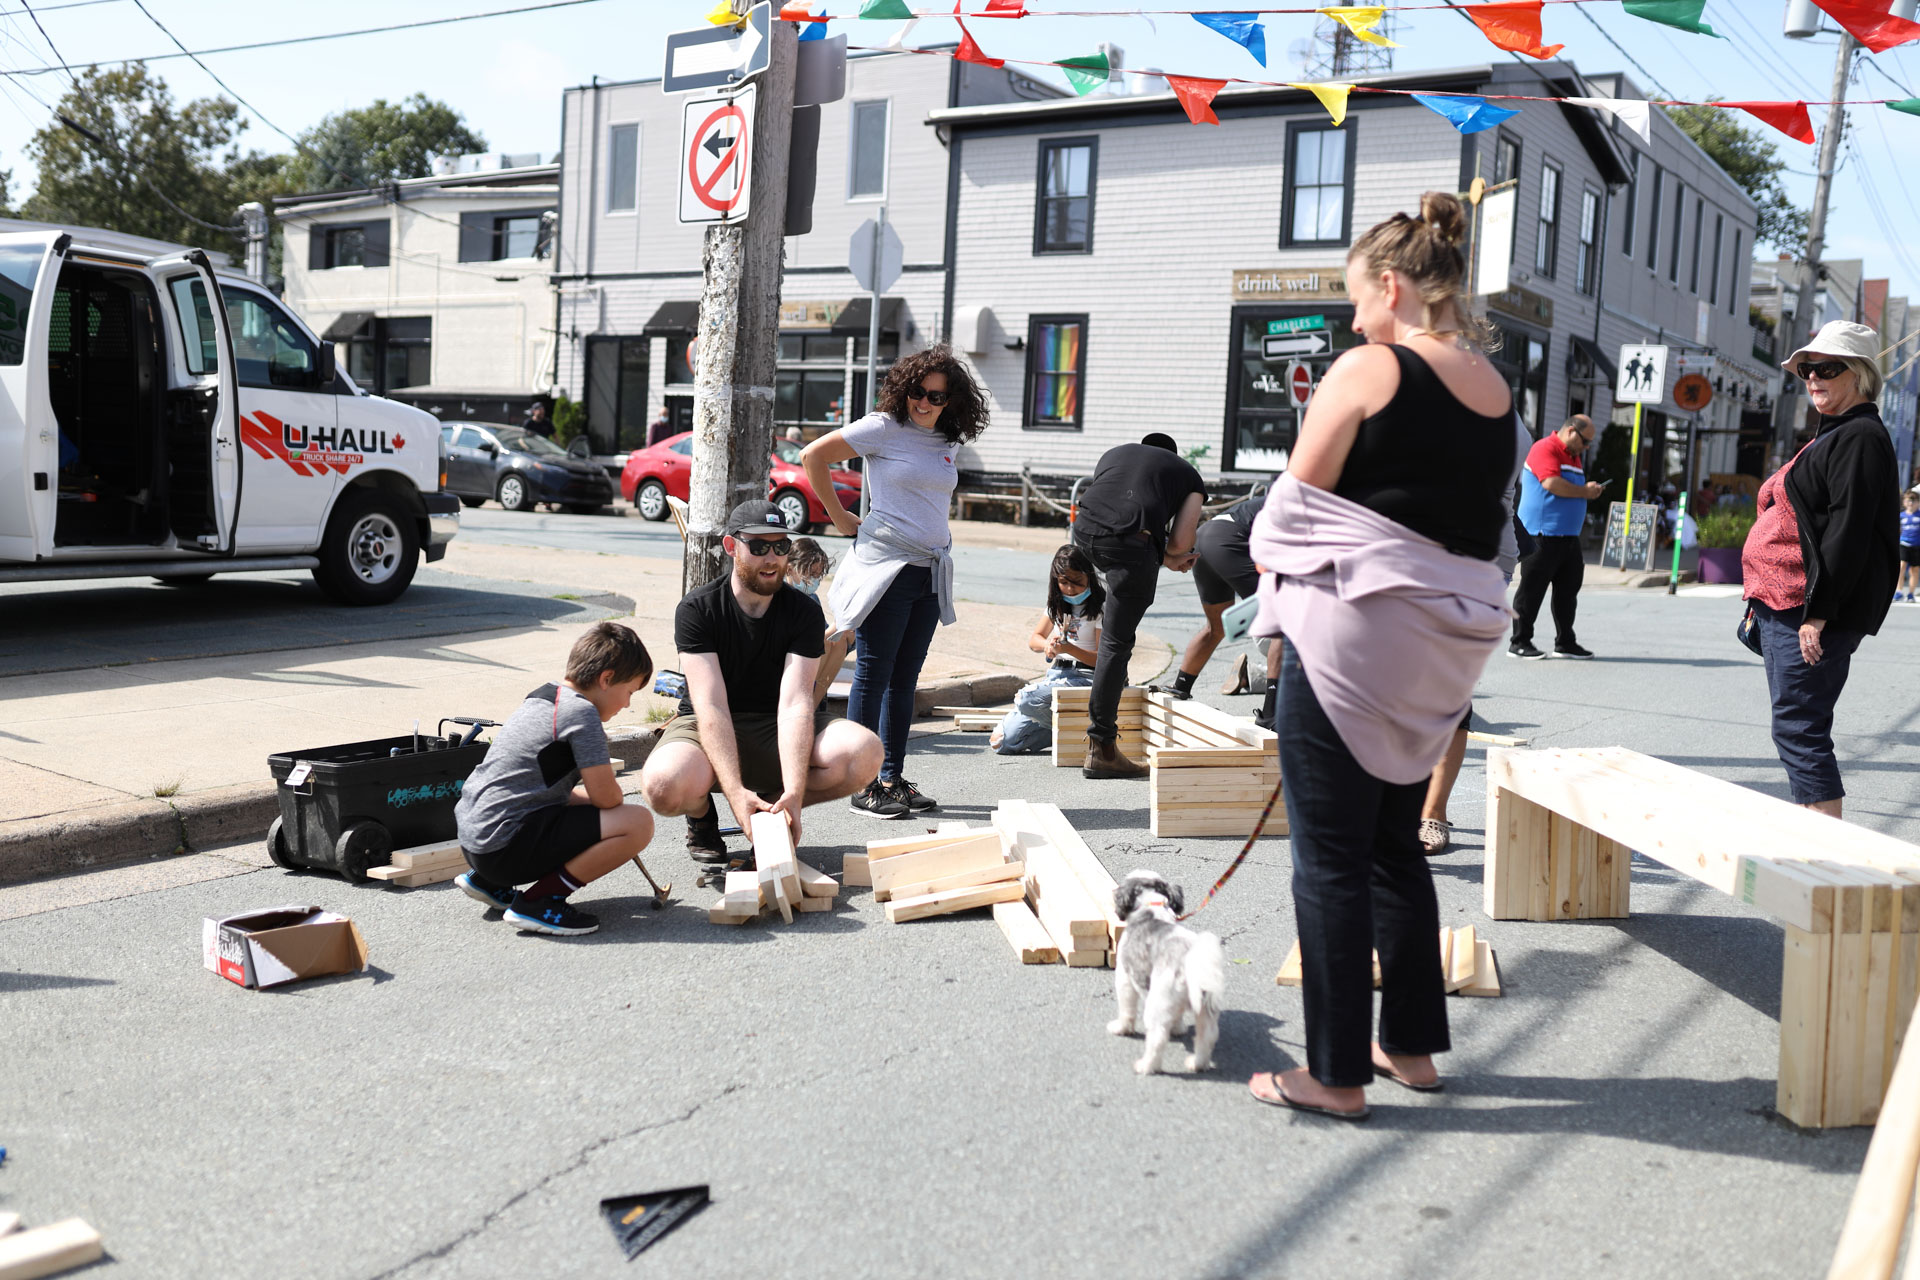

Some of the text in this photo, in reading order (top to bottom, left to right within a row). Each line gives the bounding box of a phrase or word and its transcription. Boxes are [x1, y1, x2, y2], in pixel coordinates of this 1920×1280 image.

[1238, 274, 1281, 291] drink
[1286, 273, 1319, 291] well
[1270, 318, 1311, 333] CHARLES
[284, 424, 394, 454] U-HAUL
[302, 453, 361, 463] TRUCK SHARE 24/7
